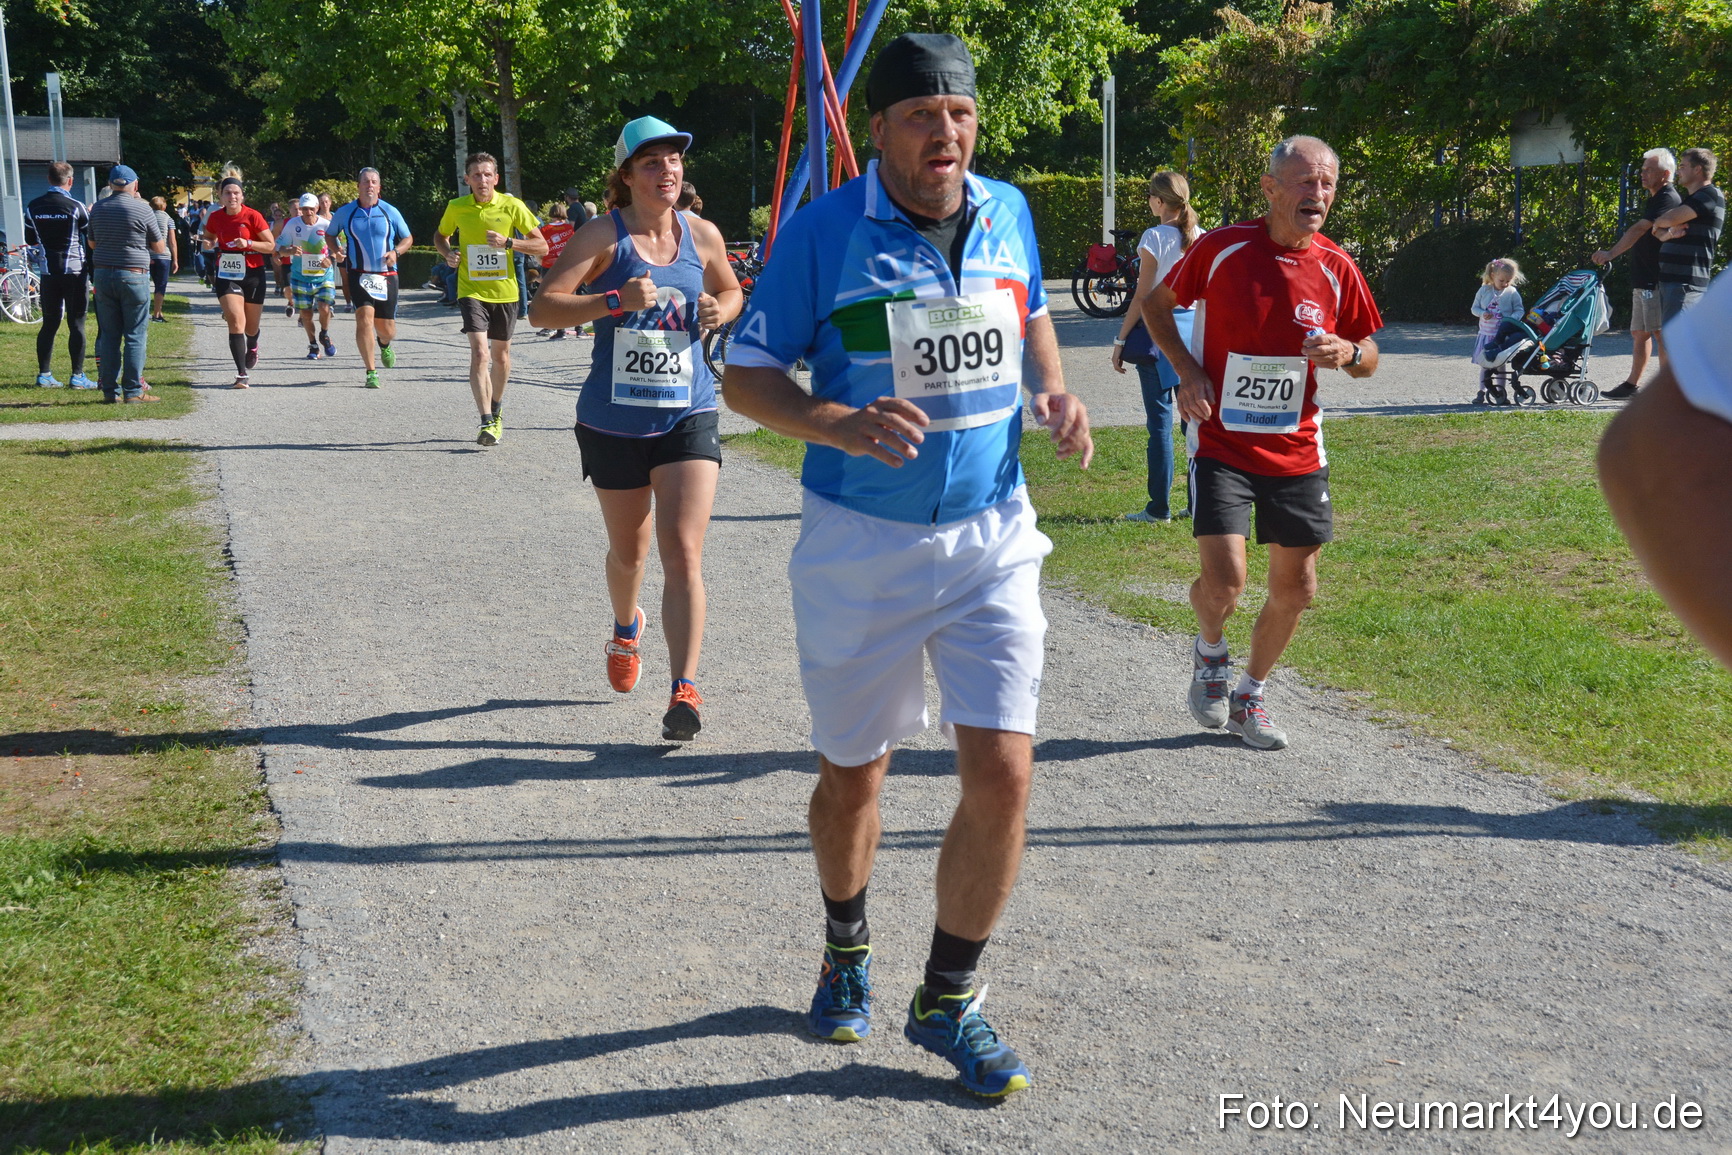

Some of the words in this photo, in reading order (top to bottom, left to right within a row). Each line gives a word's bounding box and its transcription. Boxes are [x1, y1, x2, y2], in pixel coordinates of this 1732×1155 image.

[222, 260, 242, 270] 2445
[308, 260, 320, 268] 182
[477, 254, 498, 266] 315
[363, 280, 383, 291] 2345
[928, 304, 985, 324] BOCK
[913, 328, 1003, 376] 3099
[625, 350, 681, 375] 2623
[1251, 363, 1286, 372] BOCK
[924, 381, 952, 390] PARTL
[955, 375, 989, 387] Neumarkt
[630, 387, 675, 398] Katharina
[1235, 376, 1294, 401] 2570
[1245, 413, 1278, 424] Rudolf
